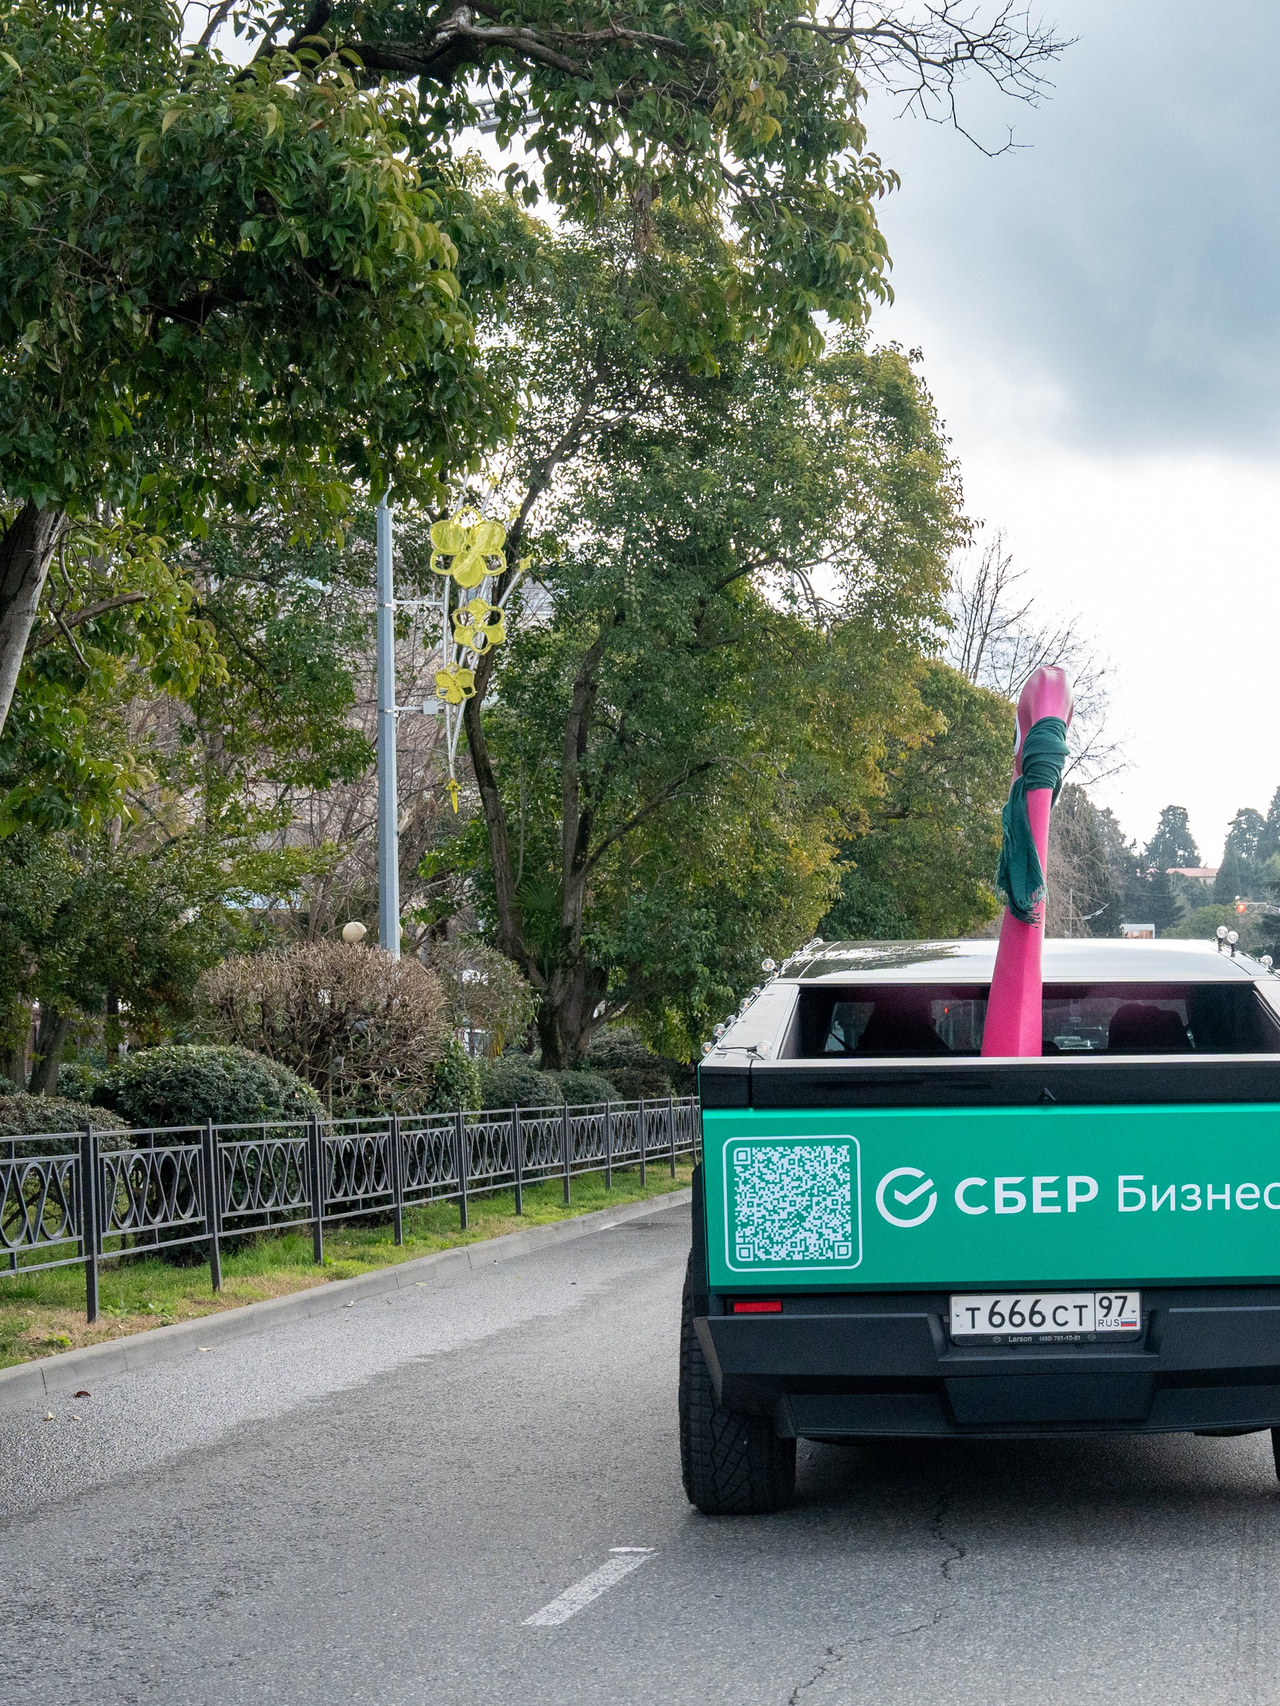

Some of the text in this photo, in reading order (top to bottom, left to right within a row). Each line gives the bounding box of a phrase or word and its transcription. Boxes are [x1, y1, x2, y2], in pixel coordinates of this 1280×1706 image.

[954, 1175, 1099, 1215] СБЕР
[1099, 1296, 1128, 1317] 97
[1098, 1318, 1119, 1327] RUS
[1008, 1335, 1033, 1343] Larson
